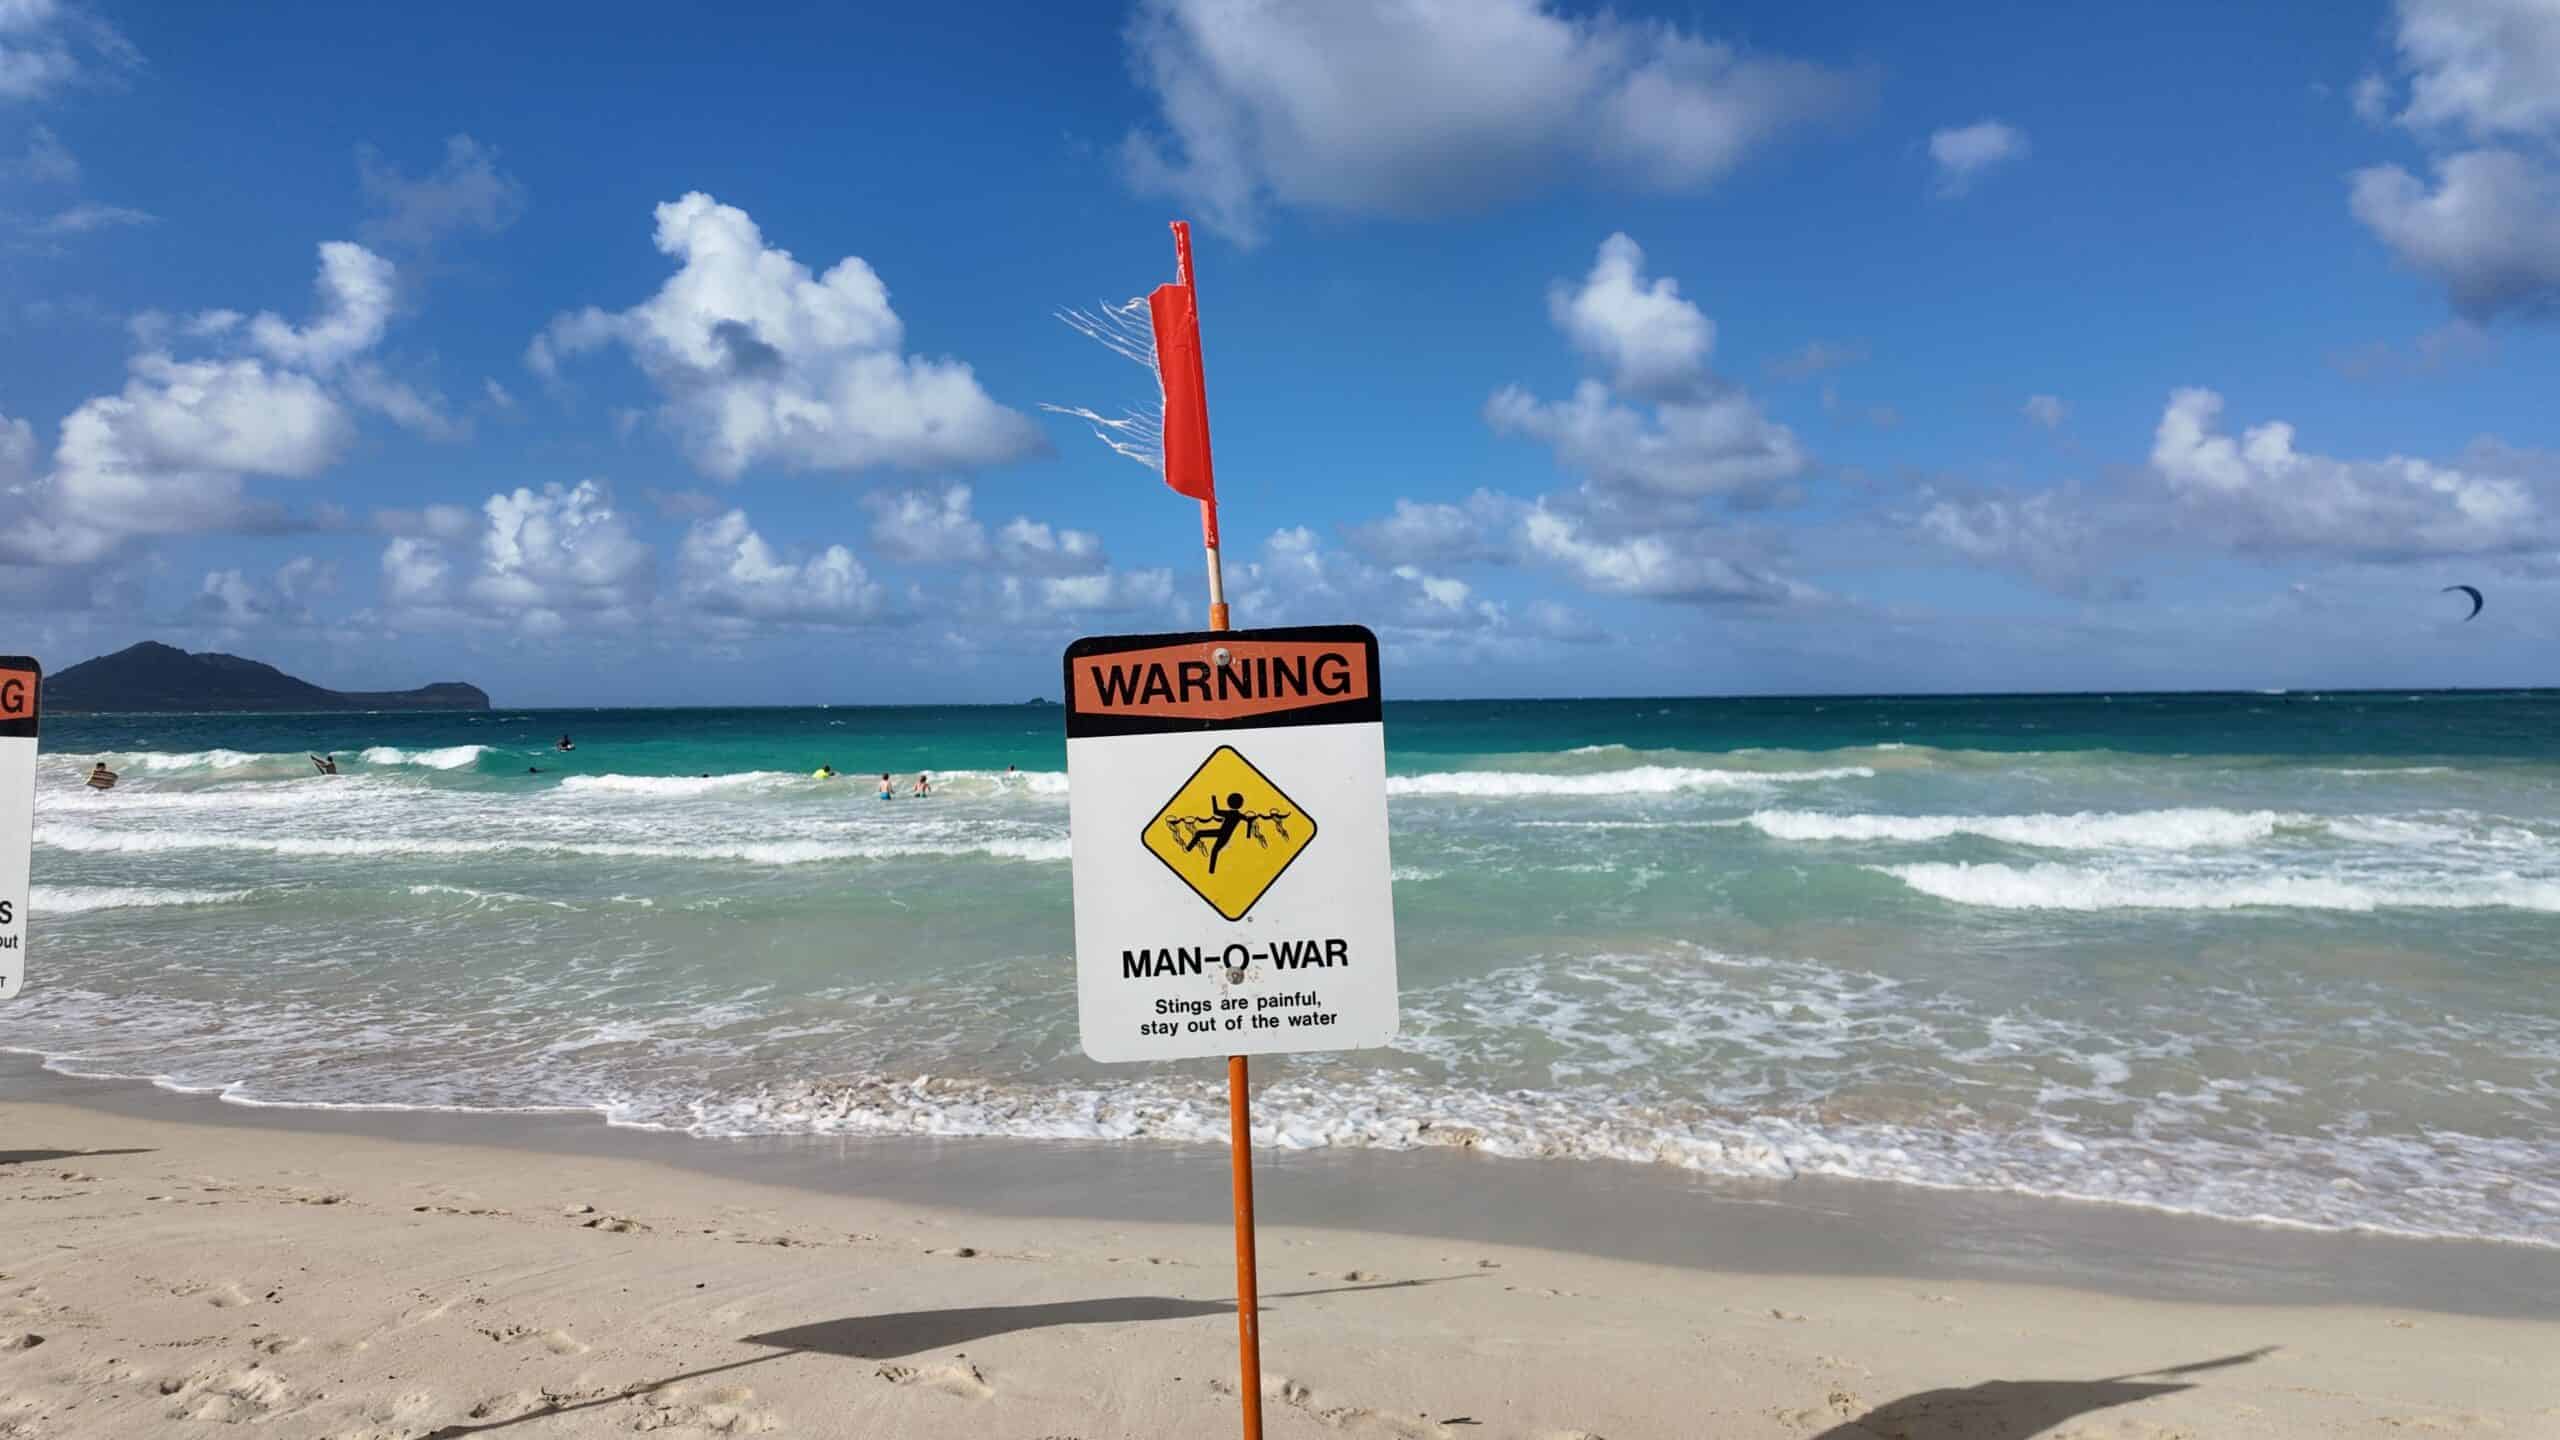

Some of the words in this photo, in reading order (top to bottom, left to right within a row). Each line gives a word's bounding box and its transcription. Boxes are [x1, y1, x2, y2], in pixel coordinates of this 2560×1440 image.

[1091, 652, 1352, 707] WARNING
[1122, 938, 1349, 979] MAN-O-WAR
[1155, 998, 1213, 1016] Stings
[1220, 997, 1249, 1011] are
[1256, 990, 1322, 1012] painful,
[1140, 1020, 1180, 1037] stay
[1187, 1018, 1217, 1033] out
[1224, 1014, 1243, 1031] of
[1251, 1013, 1280, 1029] the
[1287, 1011, 1338, 1027] water
